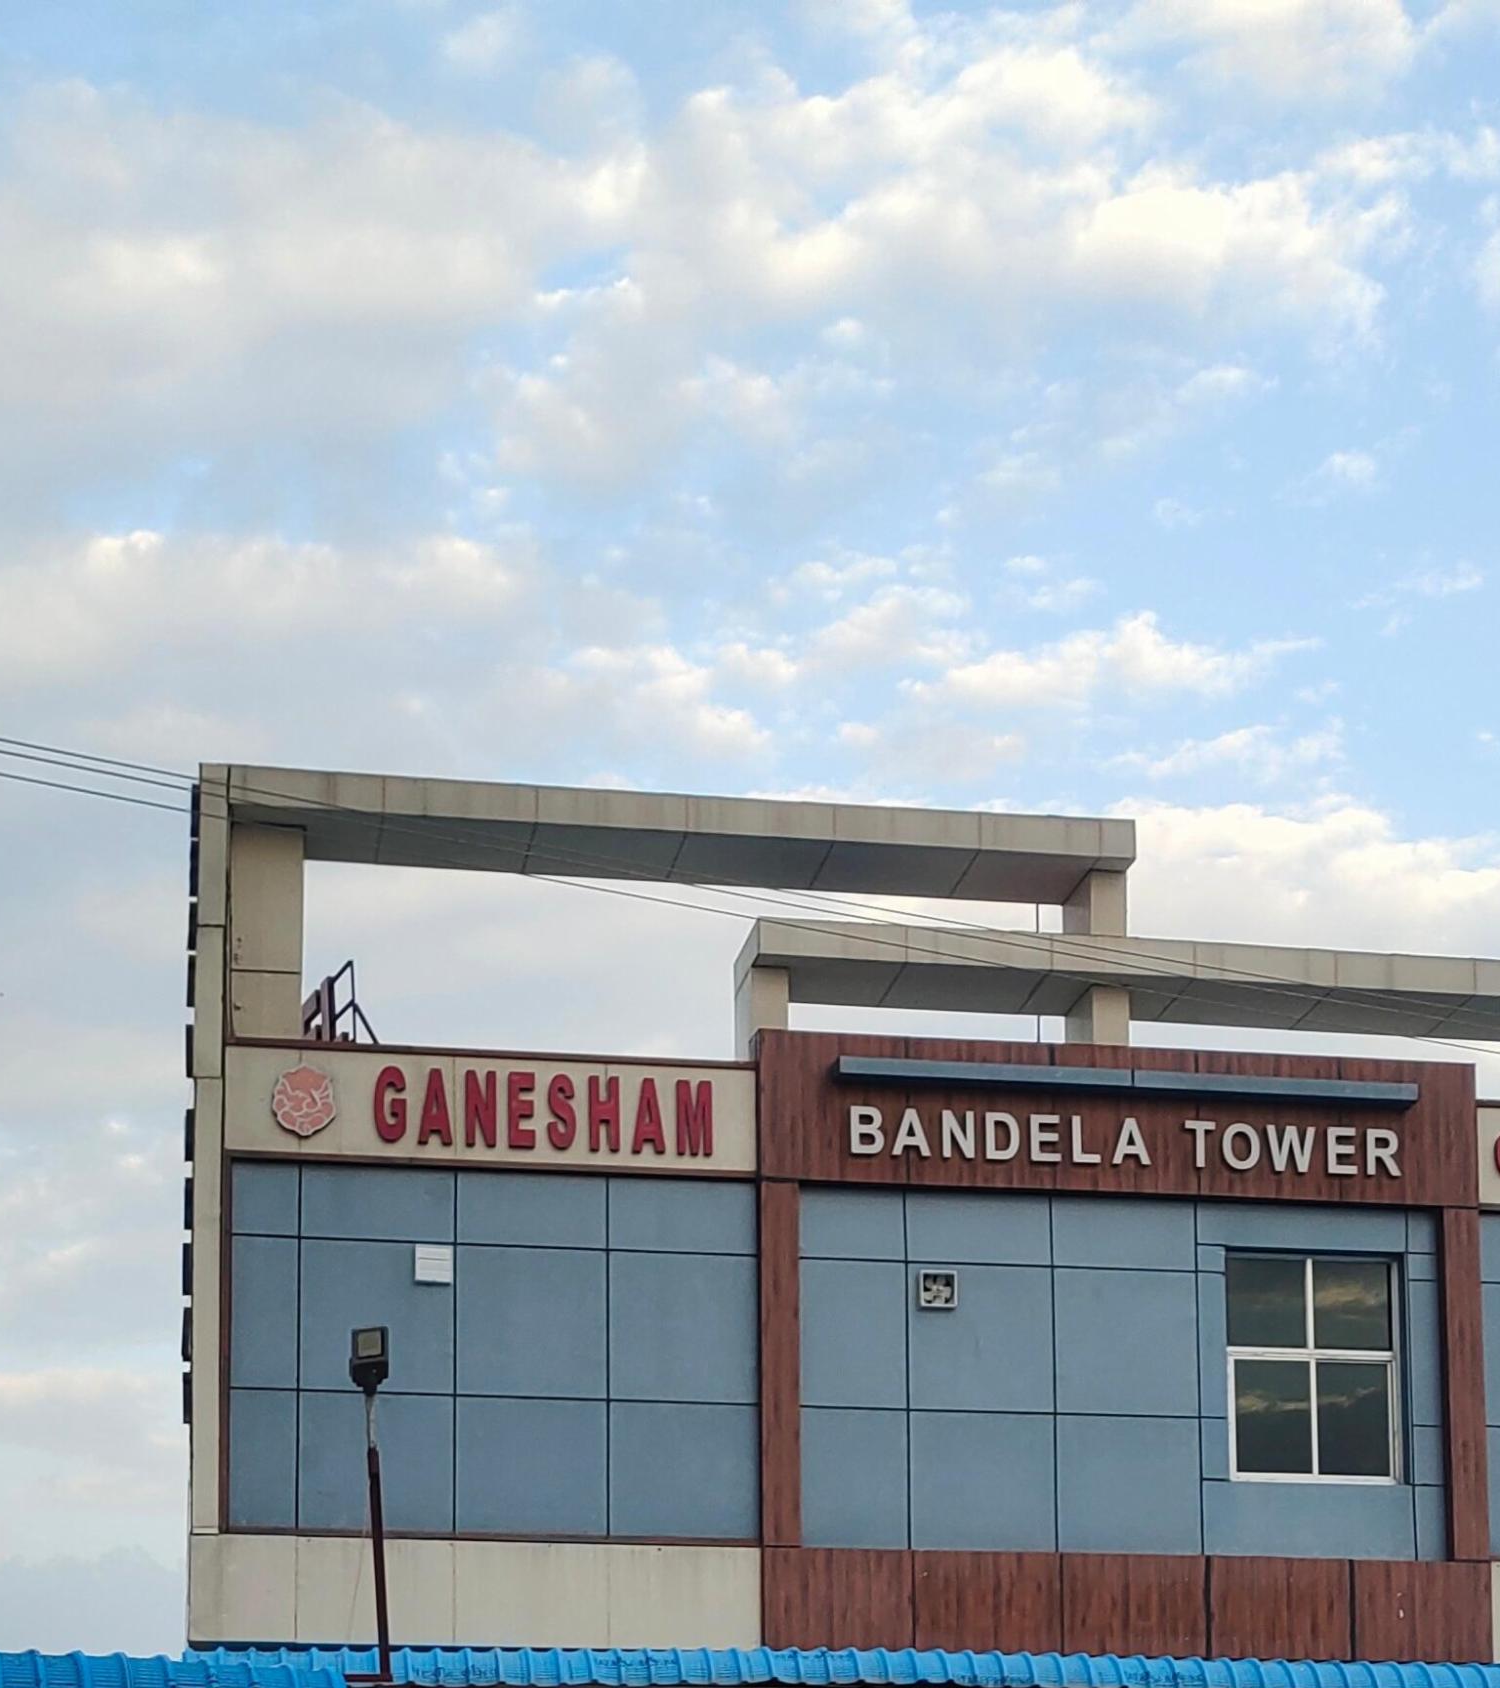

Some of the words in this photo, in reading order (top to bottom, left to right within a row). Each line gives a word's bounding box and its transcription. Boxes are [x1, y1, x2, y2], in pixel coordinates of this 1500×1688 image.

[373, 1065, 714, 1156] GANESHAM
[848, 1105, 1152, 1167] BANDELA
[1184, 1119, 1401, 1177] TOWER
